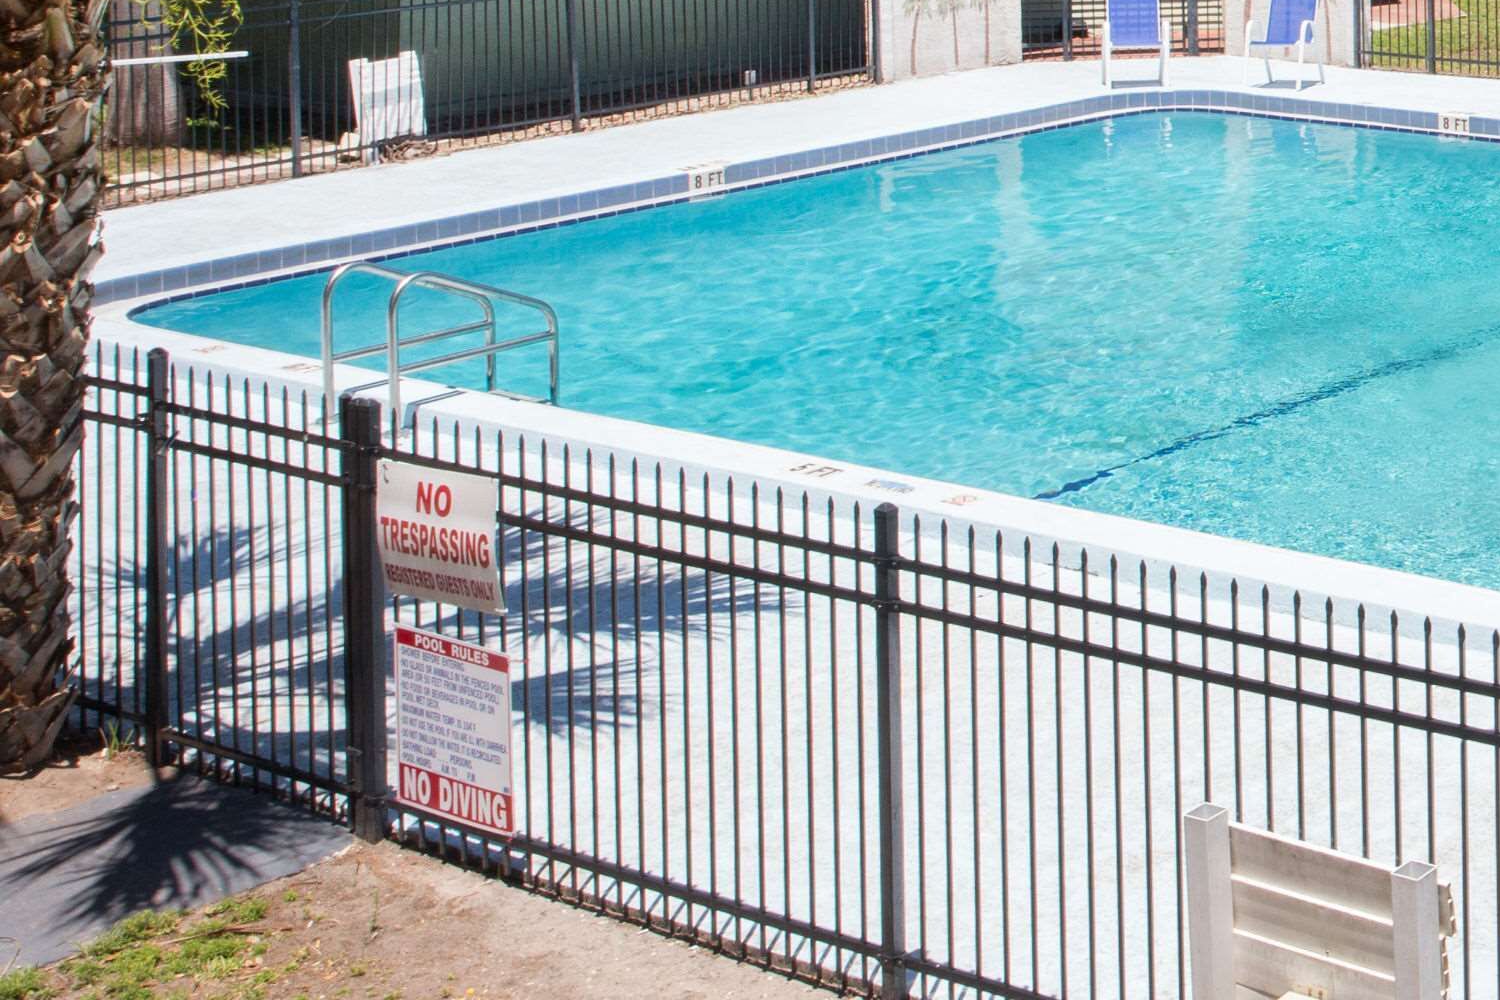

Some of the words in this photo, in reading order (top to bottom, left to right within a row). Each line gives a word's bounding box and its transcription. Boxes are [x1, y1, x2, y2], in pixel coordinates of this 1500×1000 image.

[1442, 117, 1449, 130] 8
[1455, 118, 1468, 131] FT
[695, 175, 702, 189] 8
[708, 170, 723, 187] FT
[416, 481, 453, 518] NO
[380, 516, 491, 569] TRESPASSING
[384, 563, 436, 590] REGISTERED
[436, 573, 471, 598] GUESTS
[471, 579, 495, 601] ONLY
[414, 633, 446, 654] POOL
[451, 644, 490, 666] RULES
[403, 766, 432, 806] NO
[439, 777, 508, 830] DIVING
